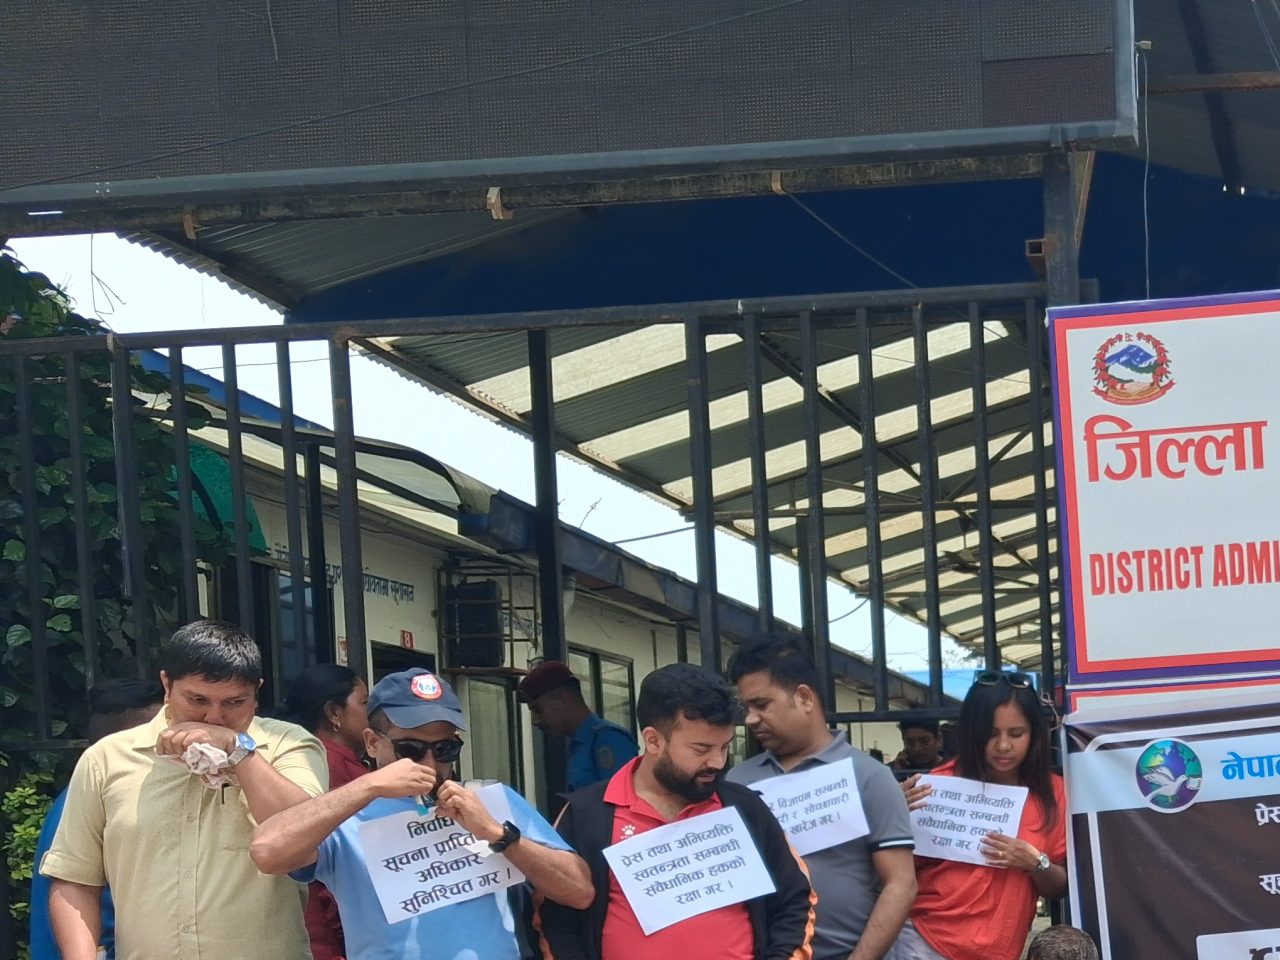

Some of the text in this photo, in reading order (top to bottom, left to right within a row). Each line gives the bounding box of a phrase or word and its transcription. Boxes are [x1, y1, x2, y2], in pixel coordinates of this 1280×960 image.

[1083, 414, 1268, 483] जिल्ला
[1089, 546, 1204, 596] DISTRICT
[940, 789, 961, 802] तथा
[381, 847, 430, 873] सूचना
[621, 823, 734, 868] प्रेस तथा अभिव्यक्ति
[632, 838, 741, 882] स्वतन्त्रता सम्बन्धी
[414, 852, 484, 884] अधिकार
[708, 855, 747, 878] हकको
[399, 870, 500, 915] सुनिश्चित गर
[705, 882, 726, 897] गर
